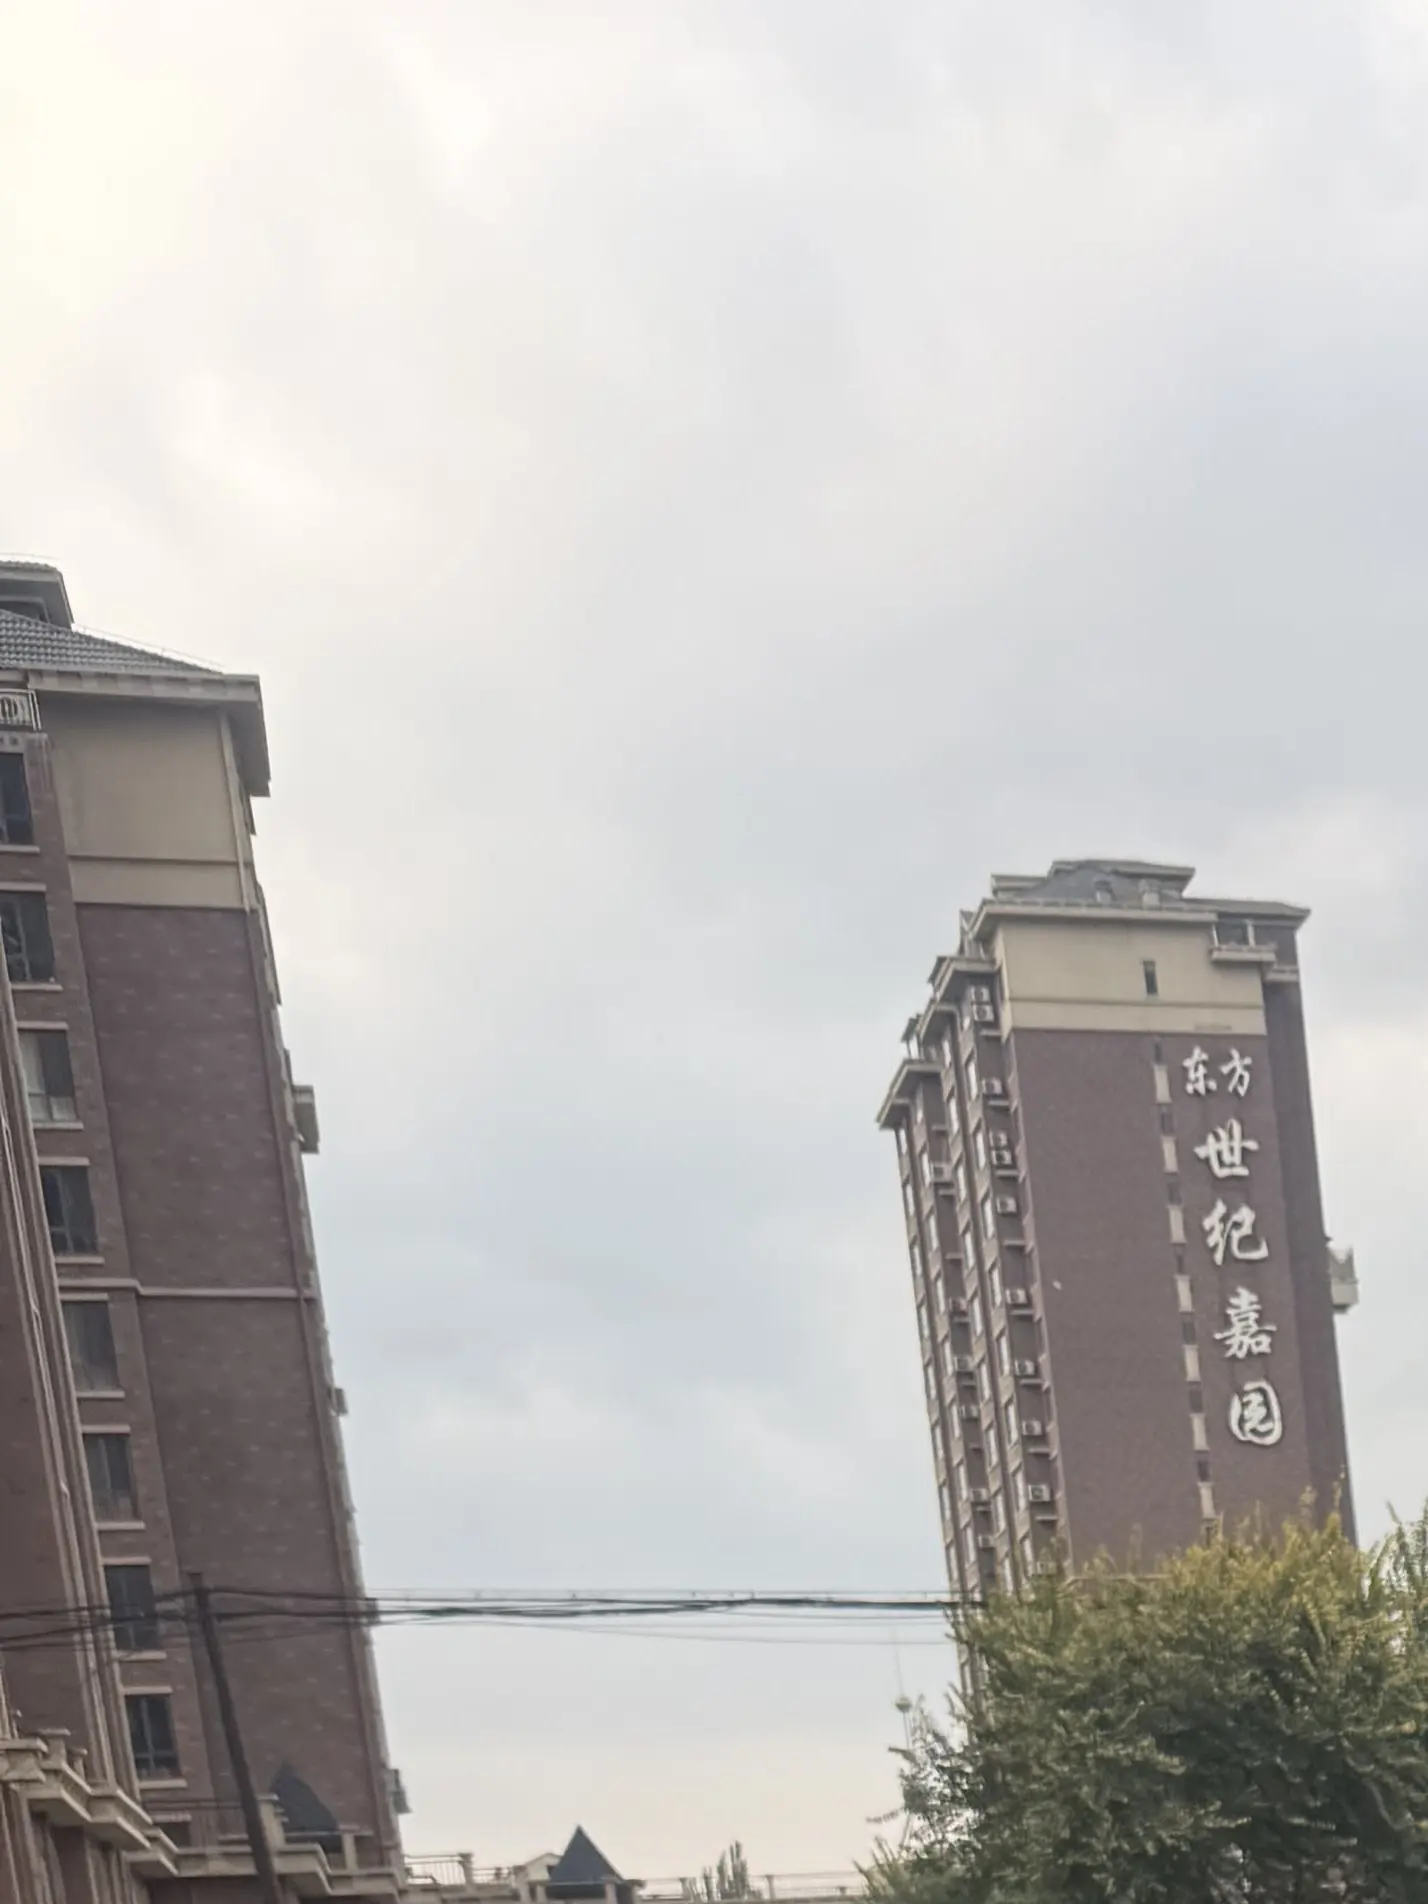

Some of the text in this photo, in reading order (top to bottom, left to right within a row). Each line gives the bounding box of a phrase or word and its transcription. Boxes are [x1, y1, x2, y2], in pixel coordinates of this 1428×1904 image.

[1181, 1046, 1255, 1098] 东方
[1194, 1119, 1283, 1447] 世纪嘉园
